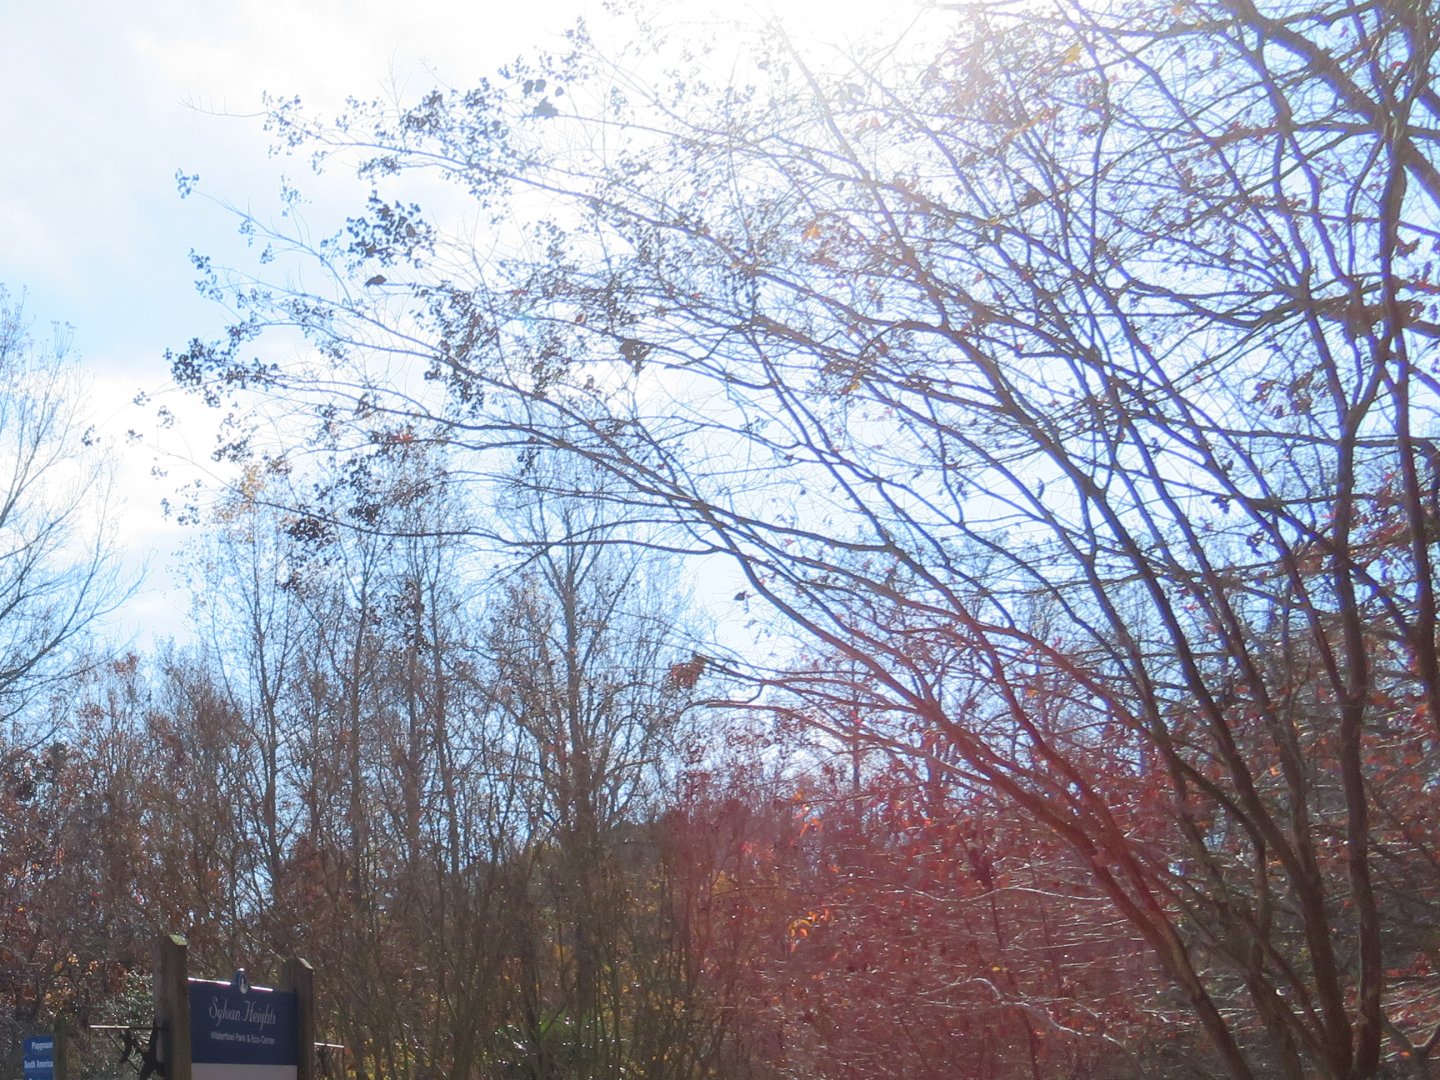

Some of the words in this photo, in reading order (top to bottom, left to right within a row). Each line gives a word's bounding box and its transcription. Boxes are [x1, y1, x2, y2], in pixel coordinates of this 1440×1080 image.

[209, 996, 241, 1027] Sylvan
[242, 1000, 276, 1031] Heights
[236, 1033, 246, 1042] Park
